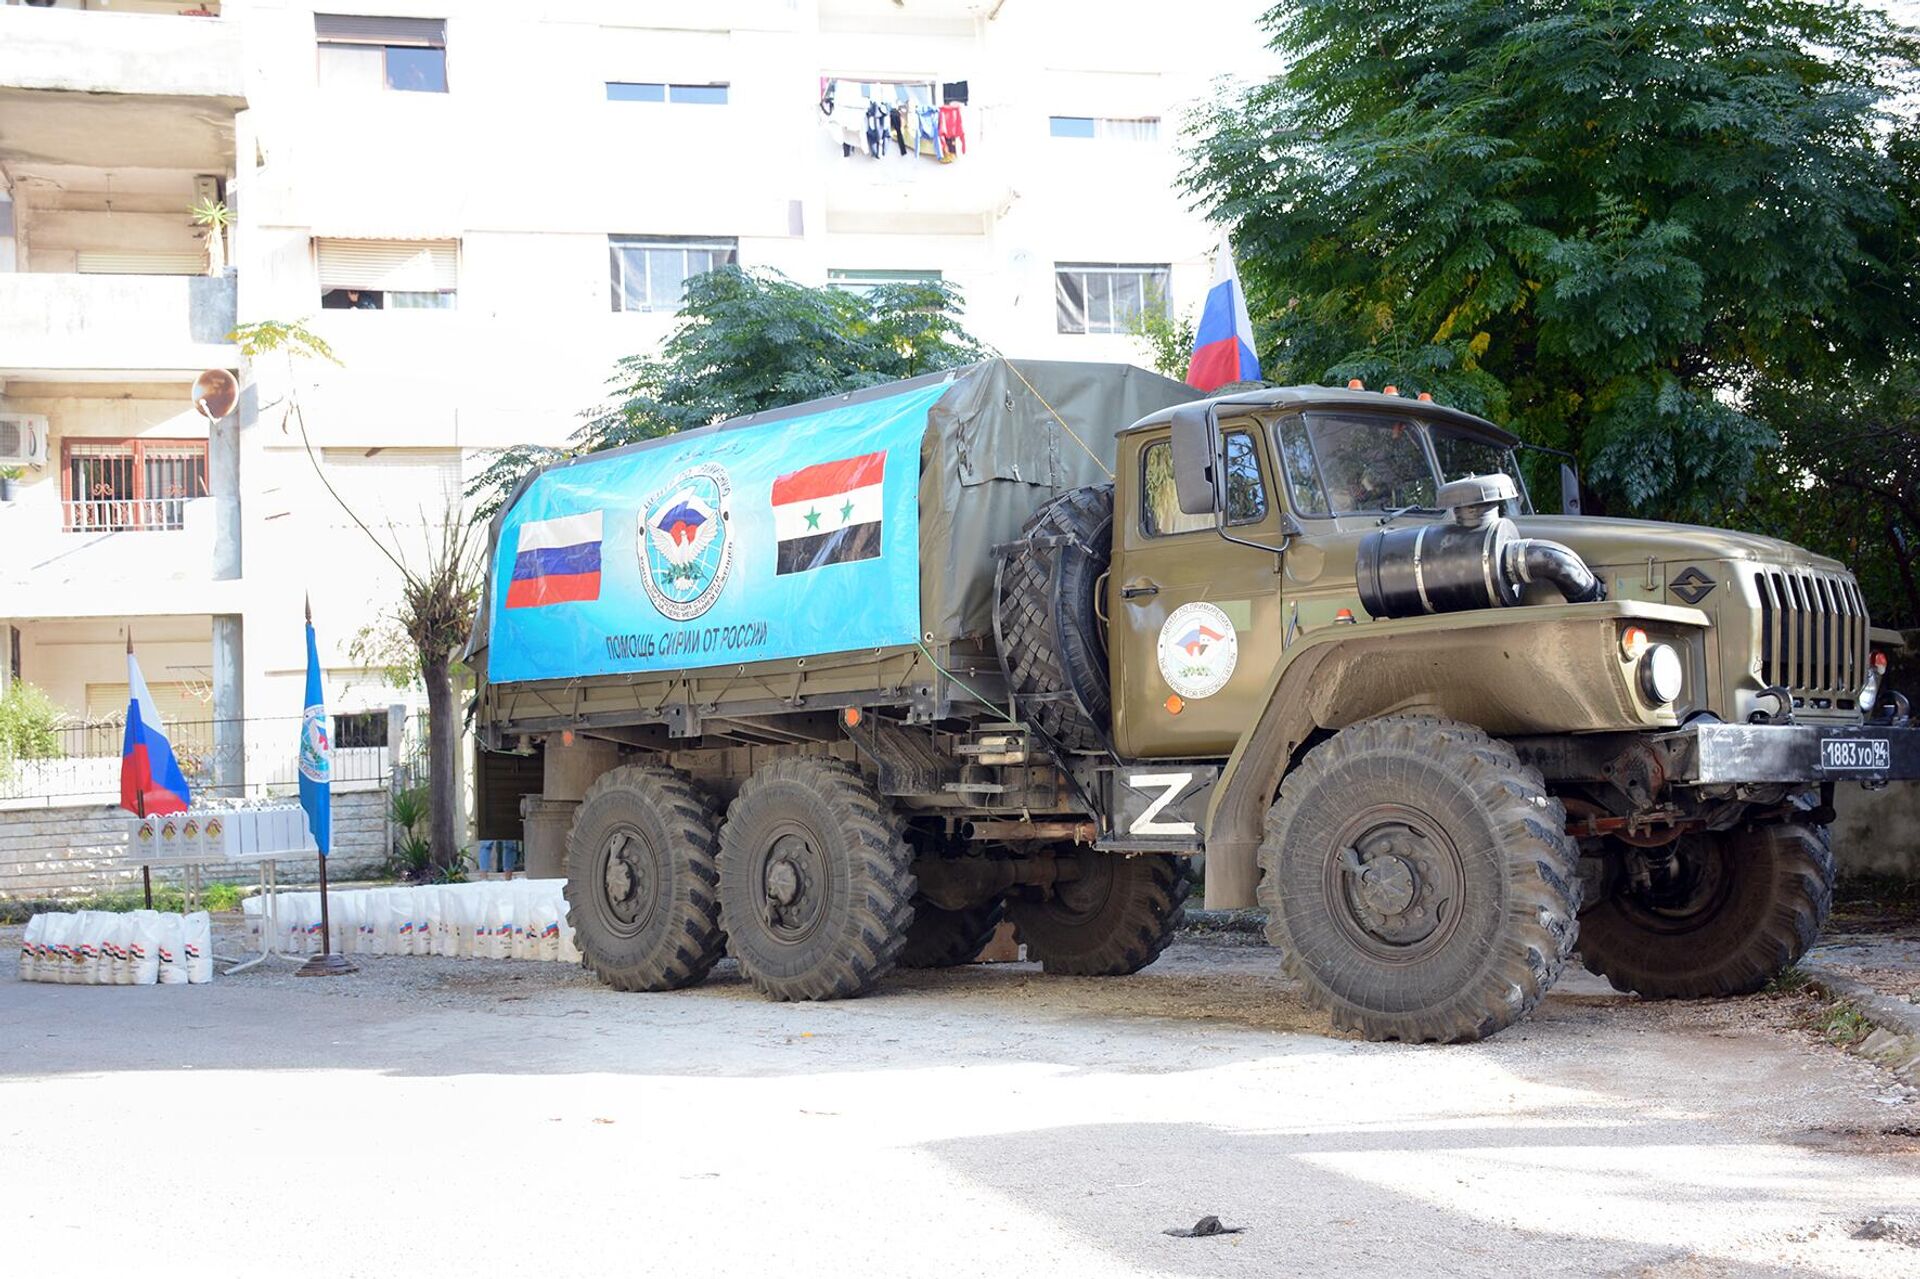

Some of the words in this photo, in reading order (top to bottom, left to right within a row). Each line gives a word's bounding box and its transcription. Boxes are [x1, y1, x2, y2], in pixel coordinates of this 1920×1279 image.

[606, 632, 655, 661] ПОМОЩЬ
[659, 629, 700, 656] СИРИИ
[703, 628, 720, 653] ОТ
[721, 621, 768, 649] РОССИИ
[1129, 772, 1197, 835] Z
